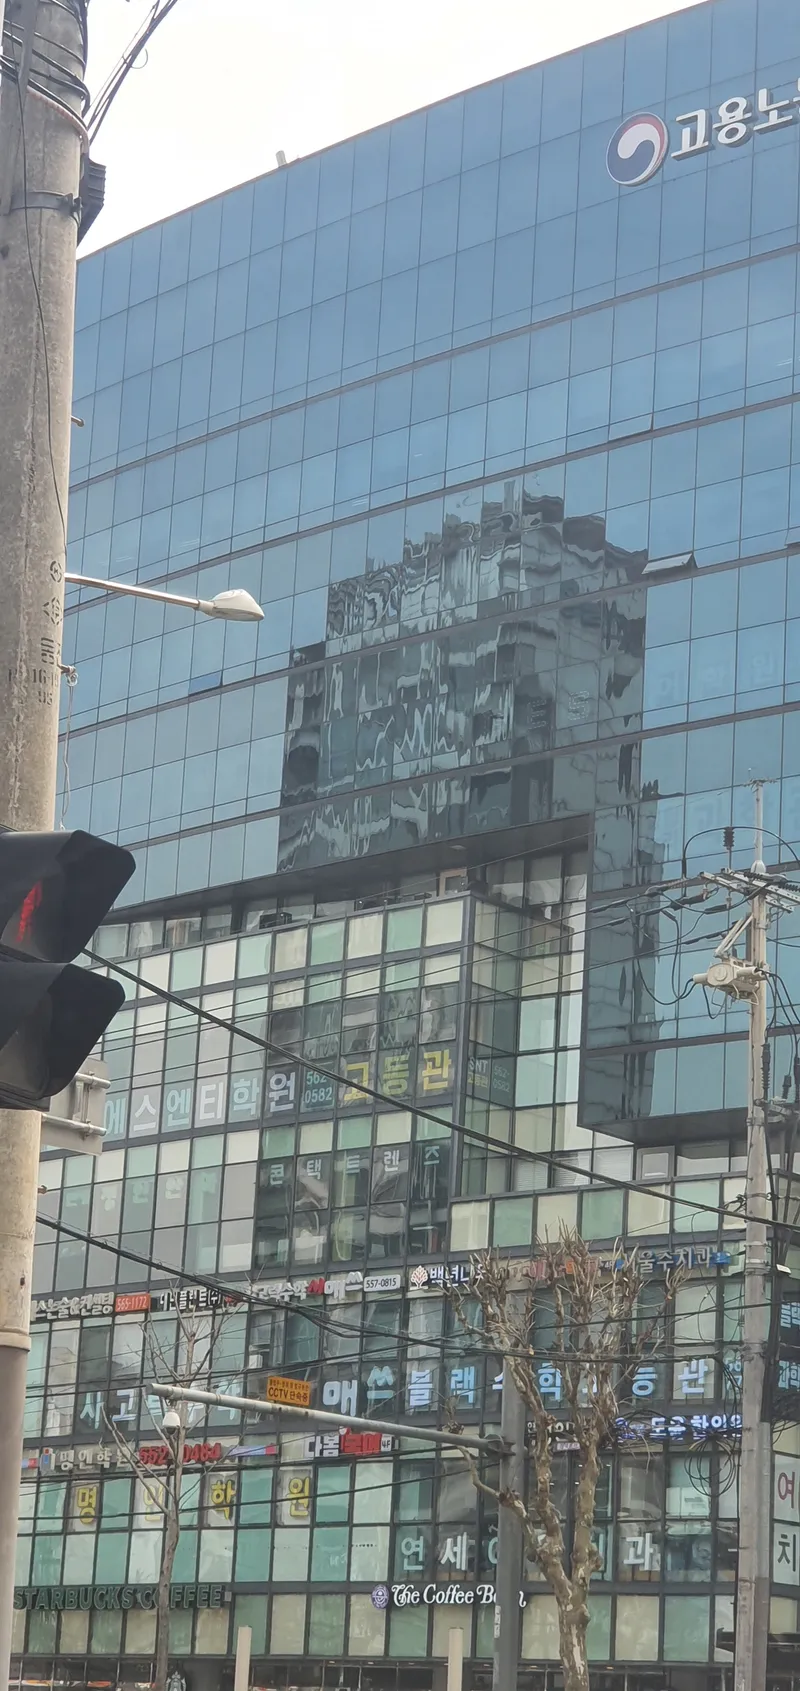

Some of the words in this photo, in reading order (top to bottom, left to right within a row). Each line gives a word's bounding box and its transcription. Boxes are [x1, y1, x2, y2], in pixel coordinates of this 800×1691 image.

[671, 77, 800, 161] 고용노
[469, 1056, 489, 1073] SNT
[304, 1086, 333, 1104] 0582
[269, 1145, 440, 1185] 콘택트렌즈
[366, 1278, 397, 1289] 557-0815
[117, 1296, 148, 1311] 565-1172
[268, 1387, 289, 1399] CCTV
[13, 1585, 135, 1610] STARBUCKS
[391, 1584, 421, 1607] The
[423, 1583, 475, 1606] Coffee
